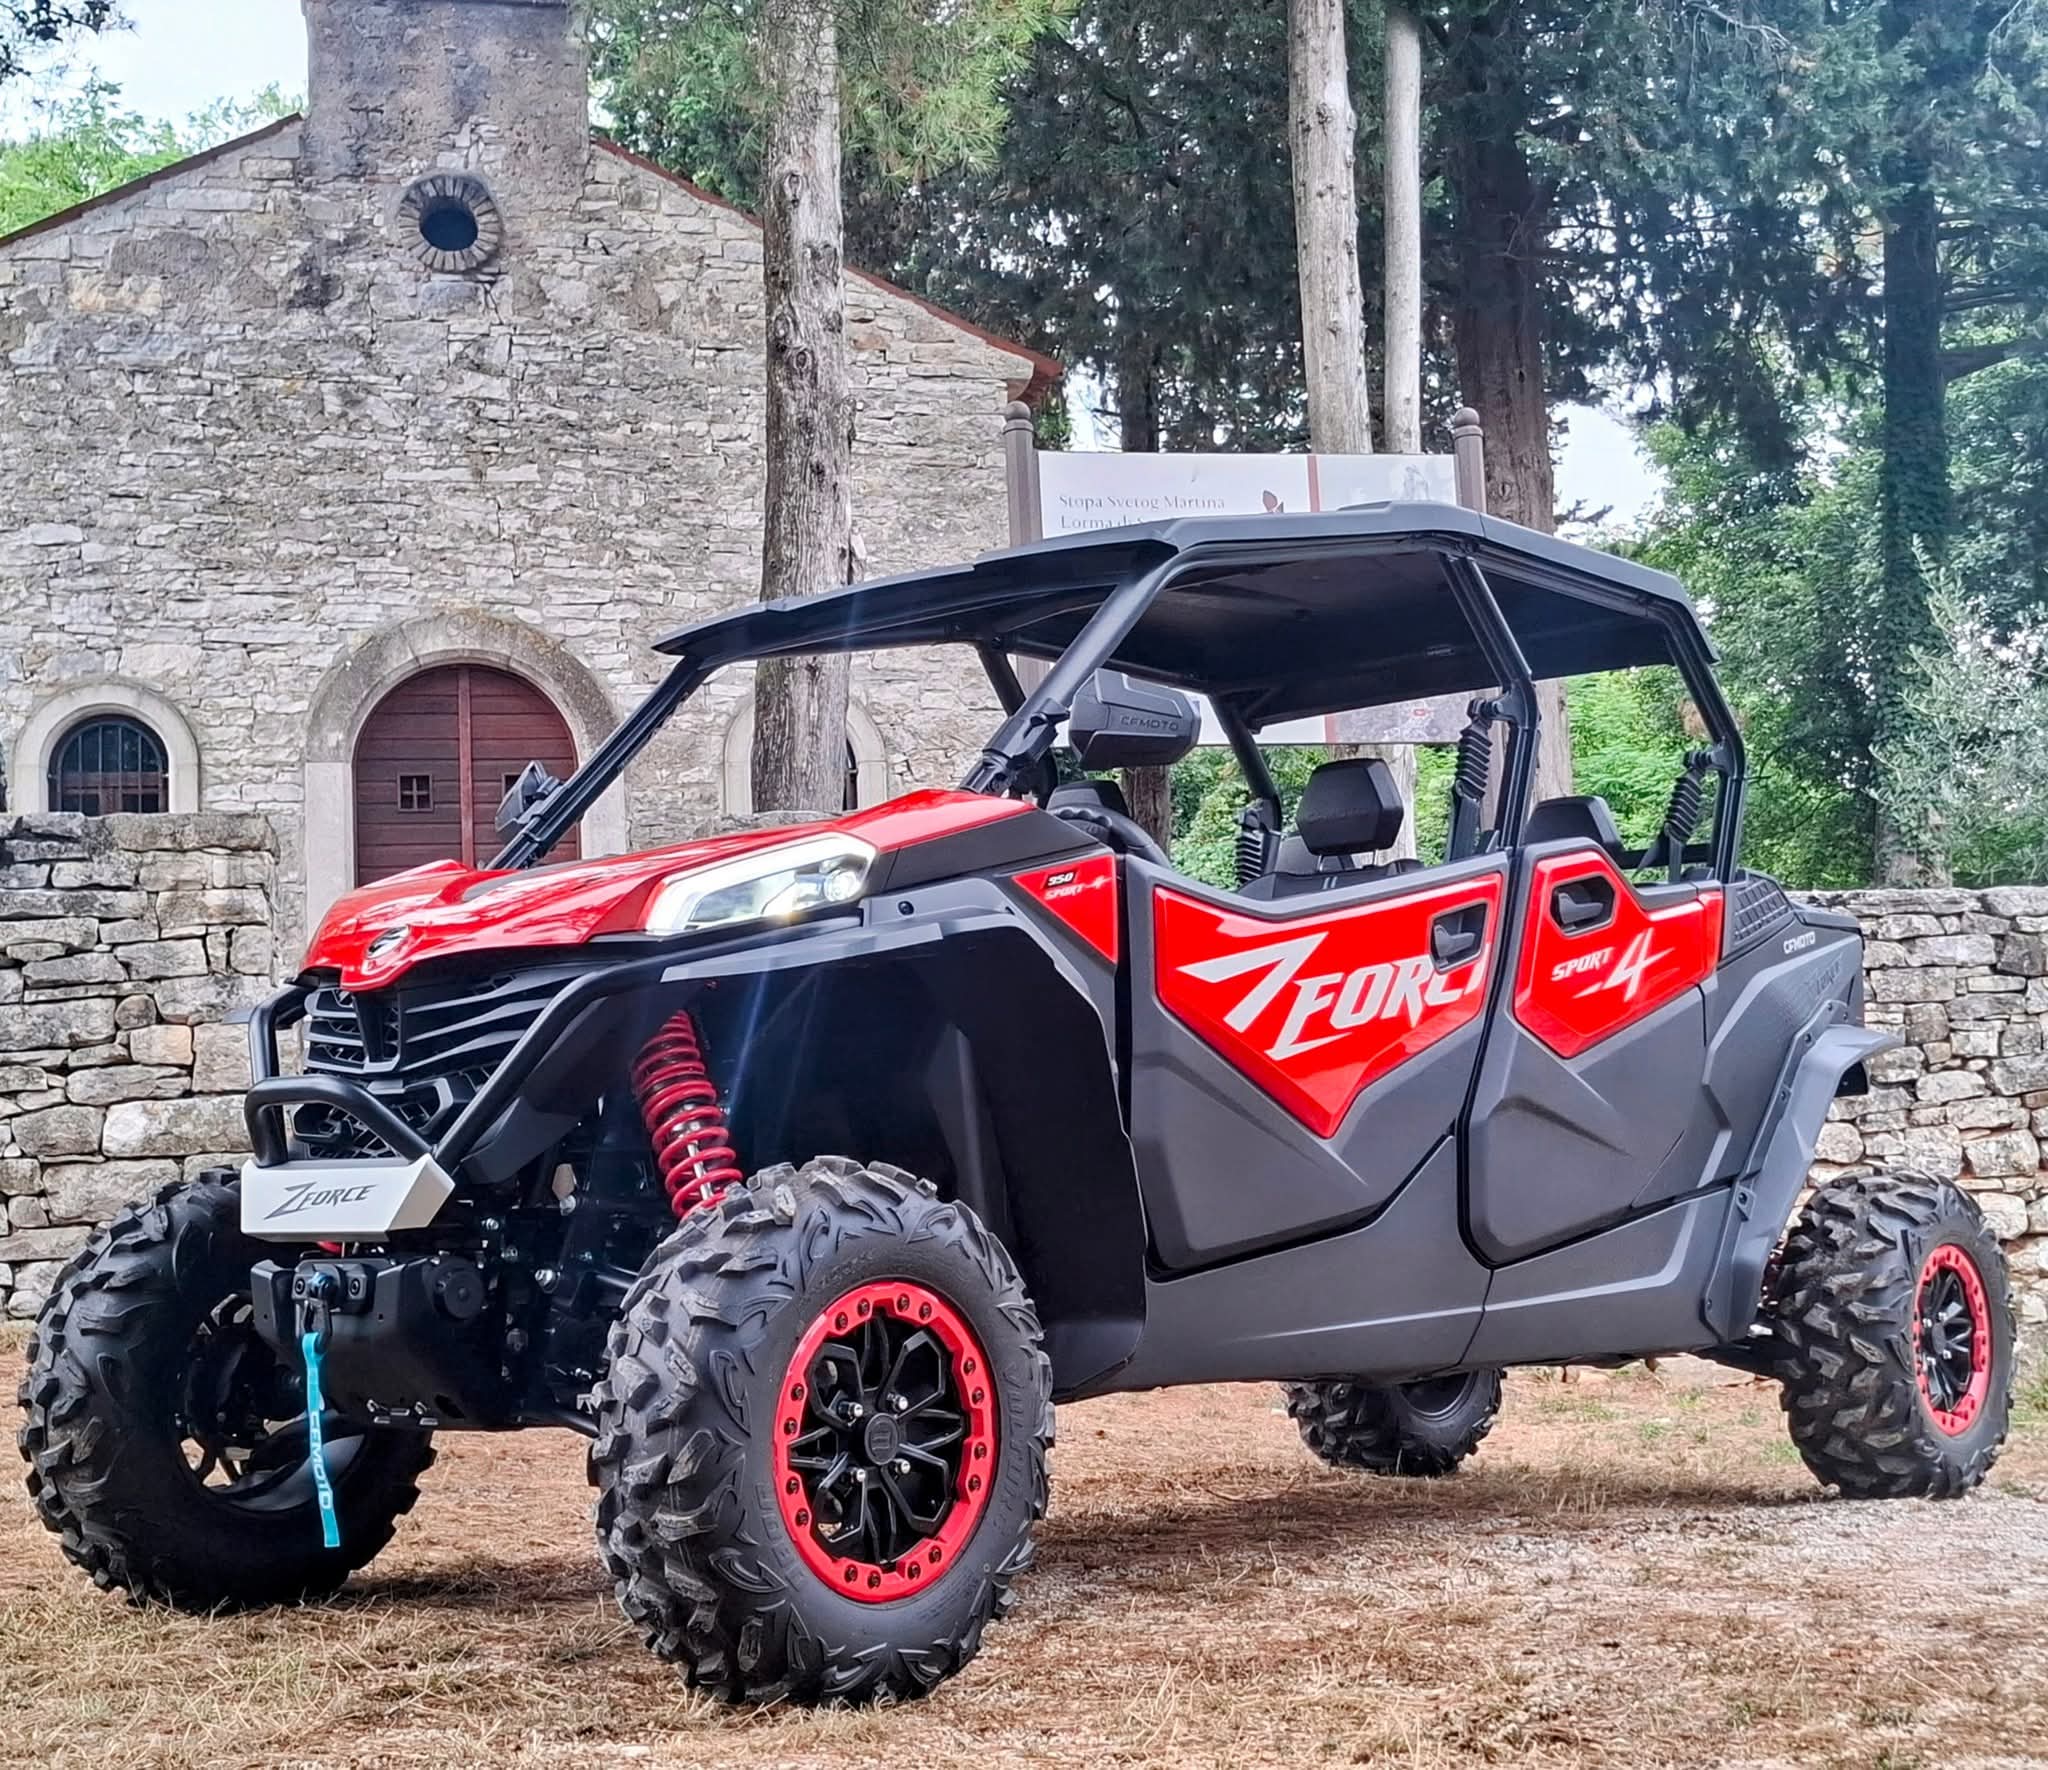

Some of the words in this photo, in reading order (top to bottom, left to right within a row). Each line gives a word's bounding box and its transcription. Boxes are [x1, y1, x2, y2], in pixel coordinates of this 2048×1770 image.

[1058, 495, 1103, 511] Stopa
[1107, 495, 1159, 511] Svetog
[1164, 495, 1225, 509] Martina
[1120, 716, 1179, 732] CFMOTO
[1783, 931, 1816, 955] CFMOTO
[1551, 946, 1615, 982] SPORT
[1590, 927, 1676, 1003] 4
[263, 1181, 379, 1221] ZFORCE
